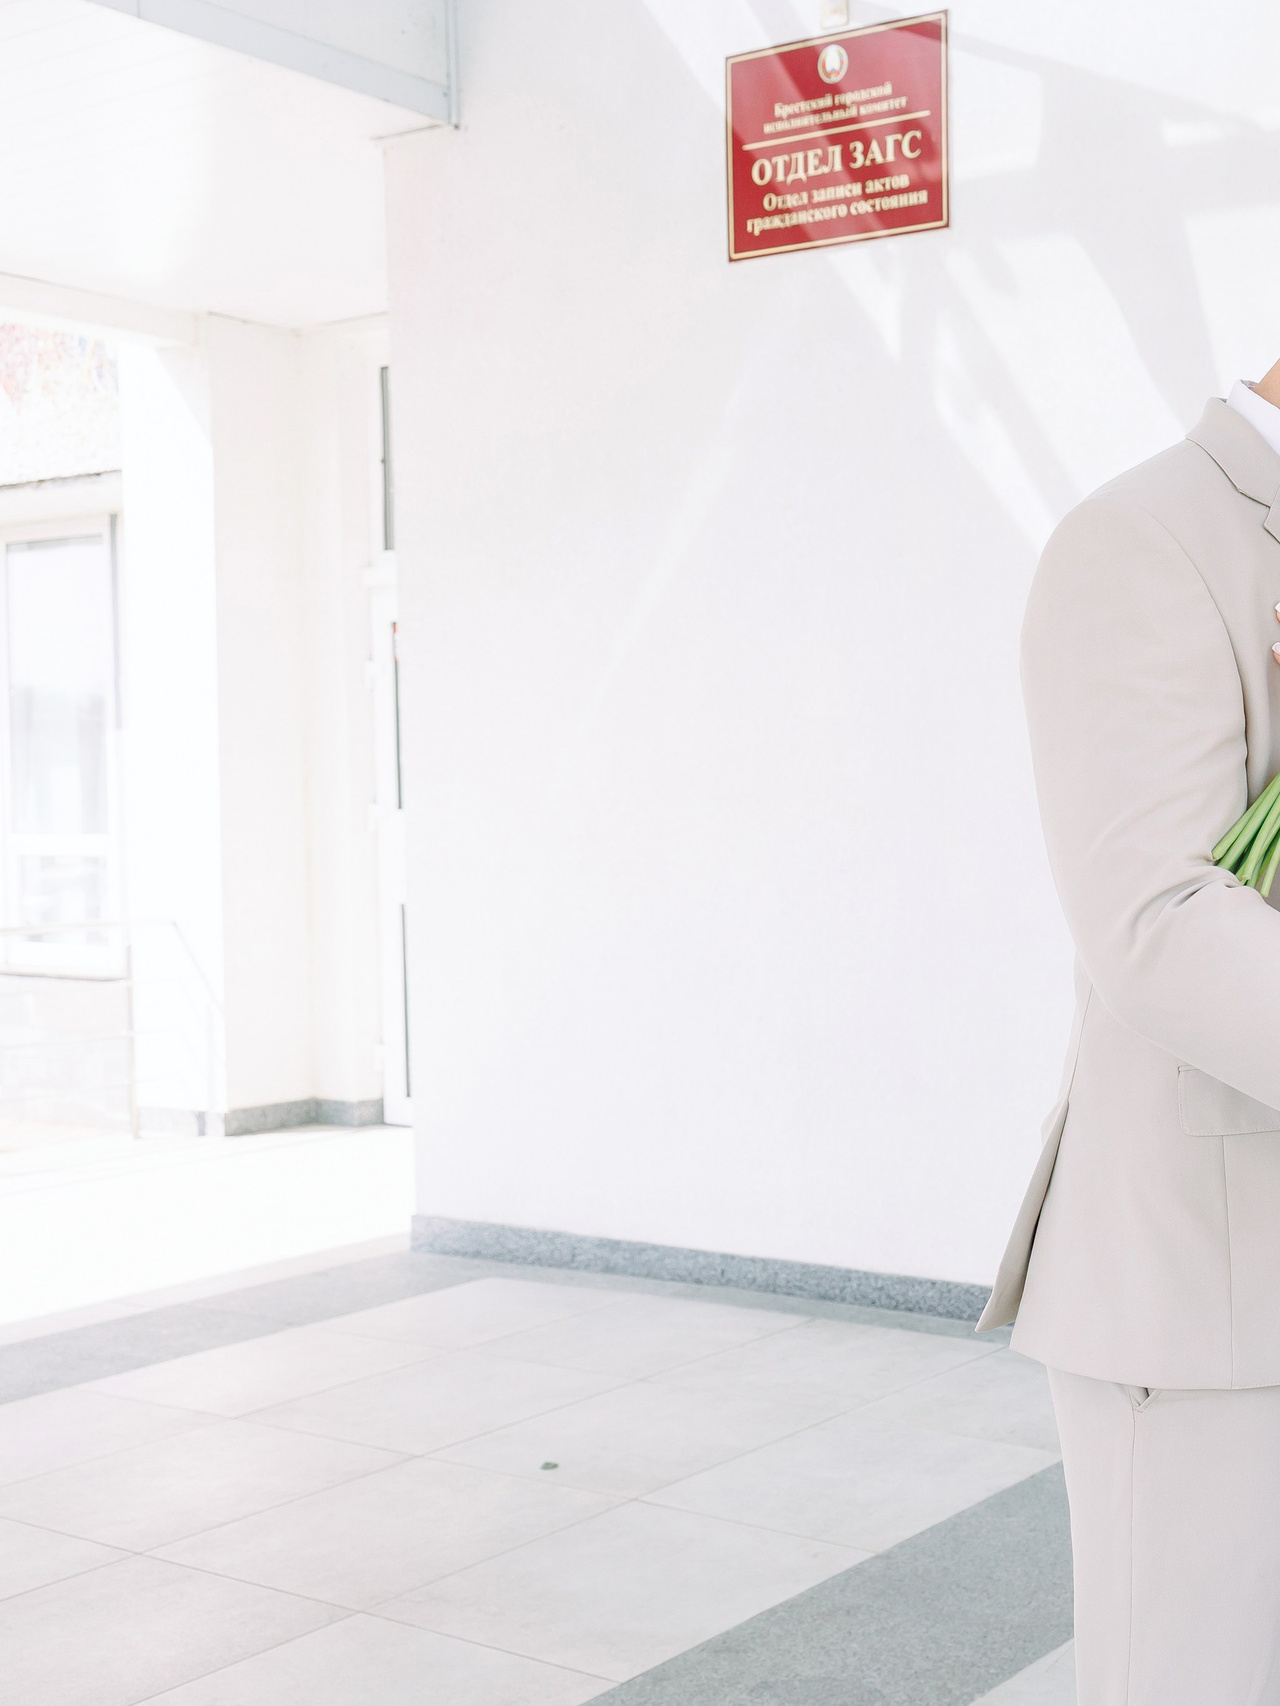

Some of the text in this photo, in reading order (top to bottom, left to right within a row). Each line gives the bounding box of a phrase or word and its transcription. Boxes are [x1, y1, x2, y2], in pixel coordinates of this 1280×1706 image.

[860, 97, 907, 115] комитет
[751, 130, 922, 186] ОТДЕЛ ЗАГС
[746, 190, 928, 236] гражданского состояния
[763, 174, 910, 211] Отдел записи актов
